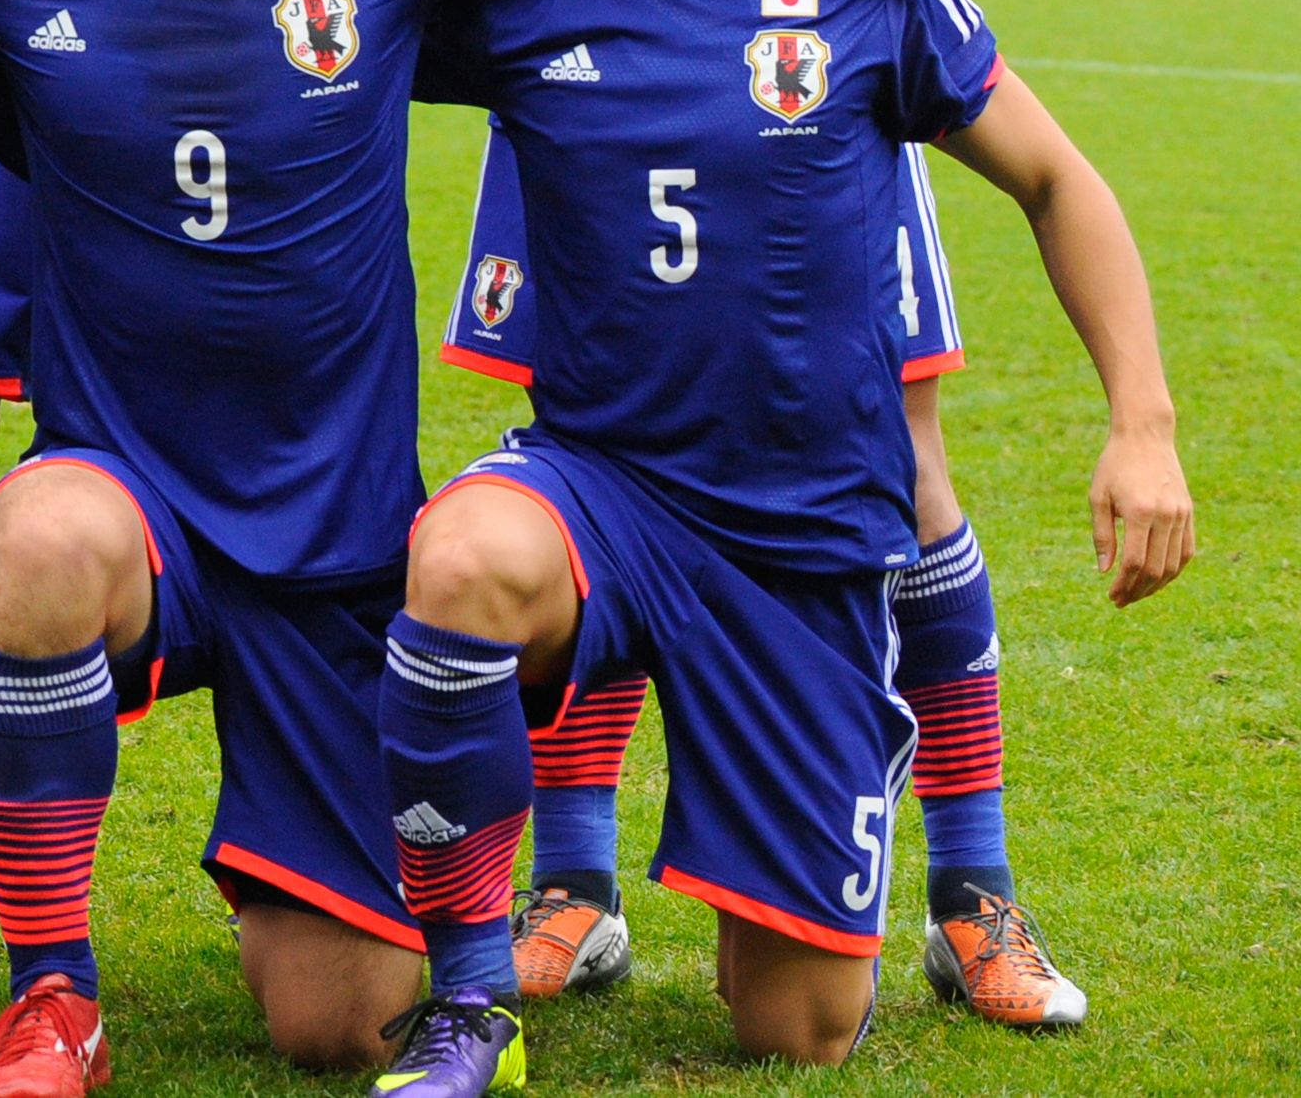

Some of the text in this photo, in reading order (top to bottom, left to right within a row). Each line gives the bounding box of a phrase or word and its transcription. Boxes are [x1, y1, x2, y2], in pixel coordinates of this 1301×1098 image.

[27, 34, 86, 53] adidas
[541, 66, 601, 82] adidas
[300, 80, 360, 99] JAPAN
[758, 125, 818, 137] JAPAN
[174, 129, 229, 241] 9
[648, 168, 699, 284] 5
[842, 795, 885, 911] 5
